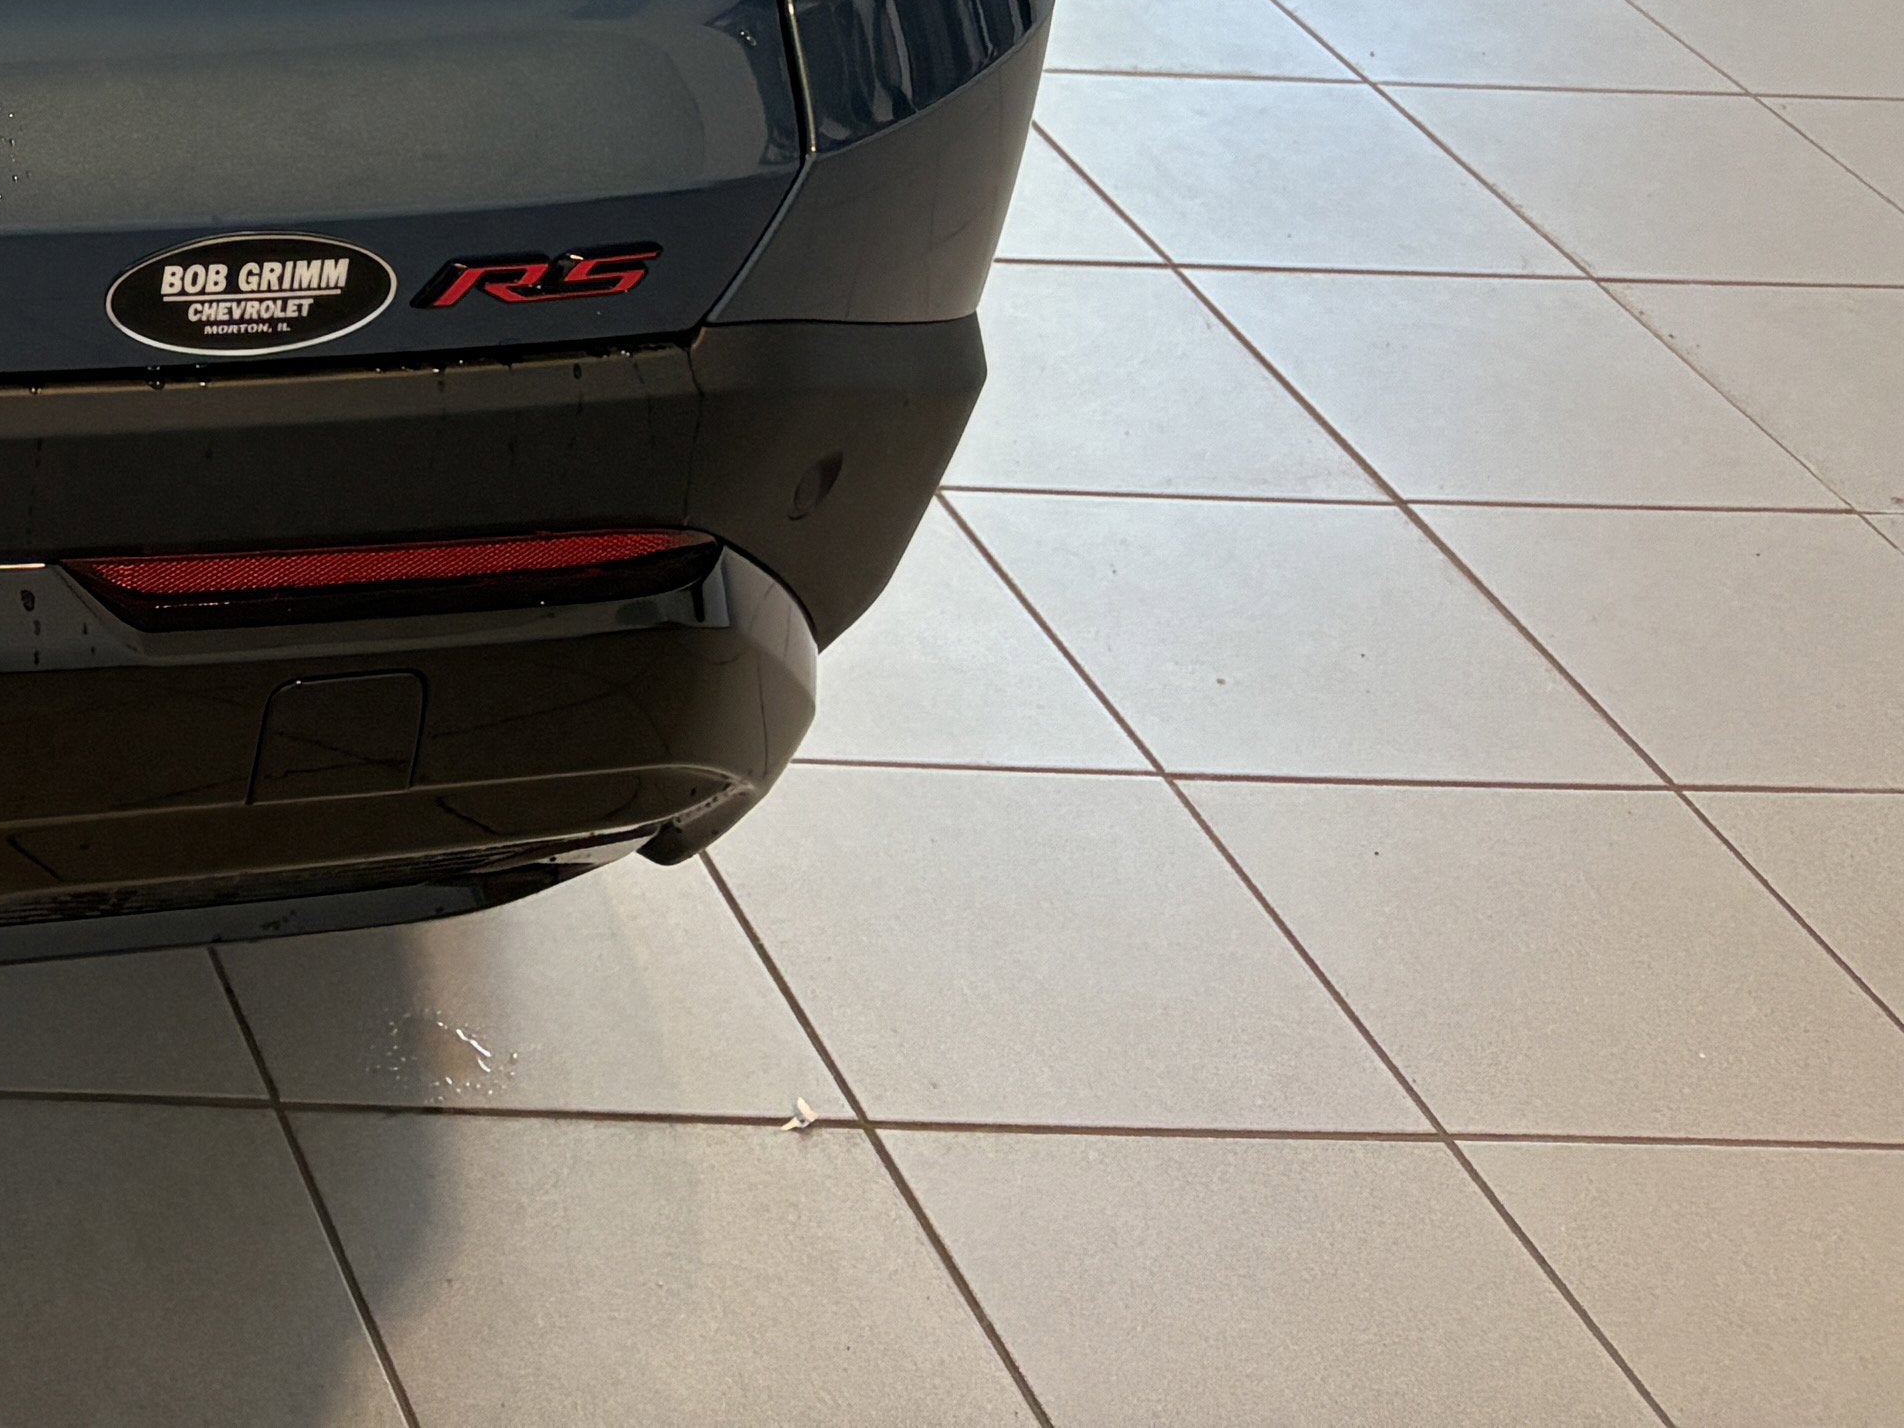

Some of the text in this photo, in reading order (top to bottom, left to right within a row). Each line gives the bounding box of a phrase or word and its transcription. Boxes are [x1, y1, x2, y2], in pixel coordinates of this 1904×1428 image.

[161, 258, 350, 295] BOB GRIMM
[410, 242, 664, 309] RS
[188, 298, 314, 322] CHEVROLET
[204, 322, 272, 335] MORTON,
